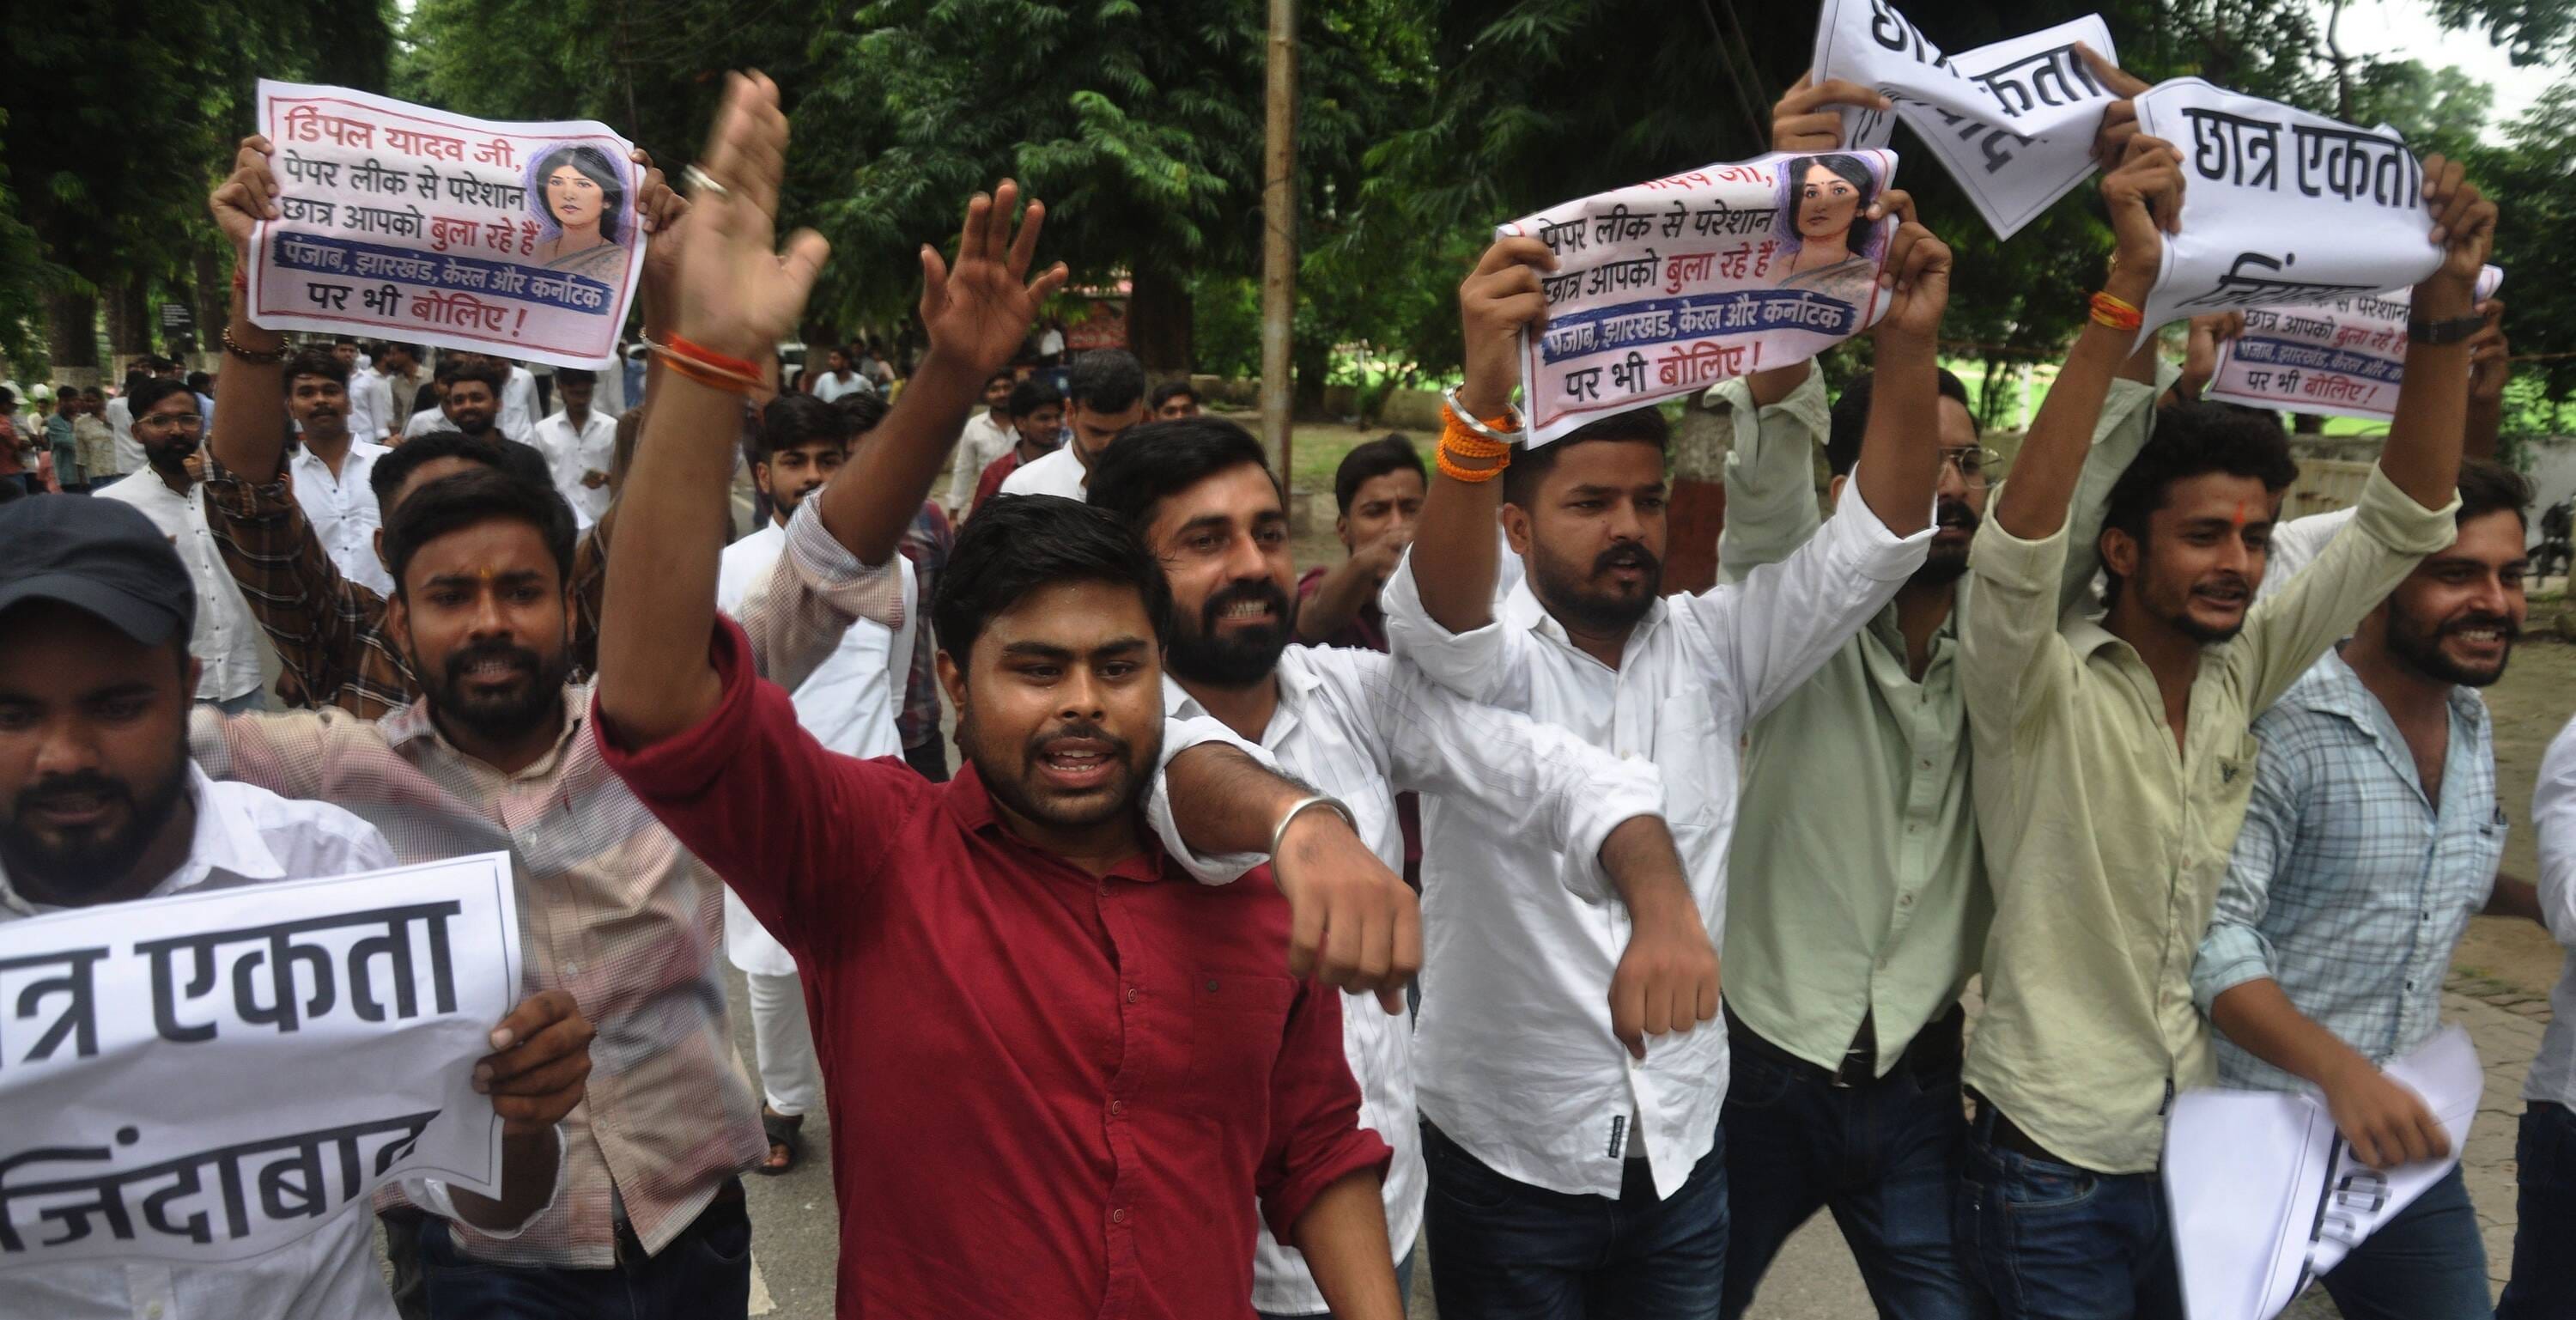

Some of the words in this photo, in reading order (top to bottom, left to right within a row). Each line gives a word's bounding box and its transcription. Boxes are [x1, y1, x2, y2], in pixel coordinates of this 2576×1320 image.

[283, 149, 341, 187] पेपर
[349, 158, 410, 195] लीक
[416, 164, 440, 200] से
[447, 171, 526, 211] परेशान
[385, 127, 466, 161] यादव
[473, 138, 522, 172] जी,
[2181, 107, 2283, 192] छात्र
[2292, 123, 2421, 210] एकता
[282, 197, 337, 227] छात्र
[342, 204, 426, 239] आपको
[431, 216, 480, 252] बुला
[485, 216, 517, 253] रहे
[520, 220, 542, 256] हैं
[1538, 217, 1588, 256] पेपर
[1595, 204, 1657, 246] लीक
[1662, 199, 1690, 238] से
[1695, 198, 1780, 237] परेशान
[283, 235, 350, 273] पंजाब,
[355, 253, 439, 284] झारखंड,
[441, 258, 490, 288] केरल
[490, 266, 528, 295] और
[531, 274, 605, 308] कर्नाटक
[1541, 270, 1586, 307] छात्र
[1587, 247, 1662, 295] आपको
[1666, 252, 1716, 295] बुला
[1720, 241, 1753, 280] रहे
[1754, 240, 1781, 278] हैं
[307, 283, 353, 311] पर
[363, 284, 404, 316] भी
[411, 290, 509, 332] बोलिए
[512, 307, 528, 338] !
[1545, 320, 1599, 356] पंजाब,
[1602, 303, 1678, 349] झारखंड,
[1680, 299, 1724, 333] केरल
[1725, 293, 1760, 327] और
[1763, 291, 1845, 329] कर्नाटक
[2245, 309, 2281, 332] छात्र
[2281, 314, 2337, 341] आपको
[2332, 325, 2372, 348] बुला
[2371, 327, 2395, 351] रहे
[1565, 366, 1603, 403] पर
[1612, 350, 1649, 393] भी
[1657, 341, 1746, 386] बोलिए
[1749, 341, 1764, 375] !
[2246, 370, 2274, 392] पर
[2278, 369, 2301, 394] भी
[2304, 373, 2367, 401] बोलिए
[2363, 386, 2379, 405] !
[134, 899, 462, 1043] एकता
